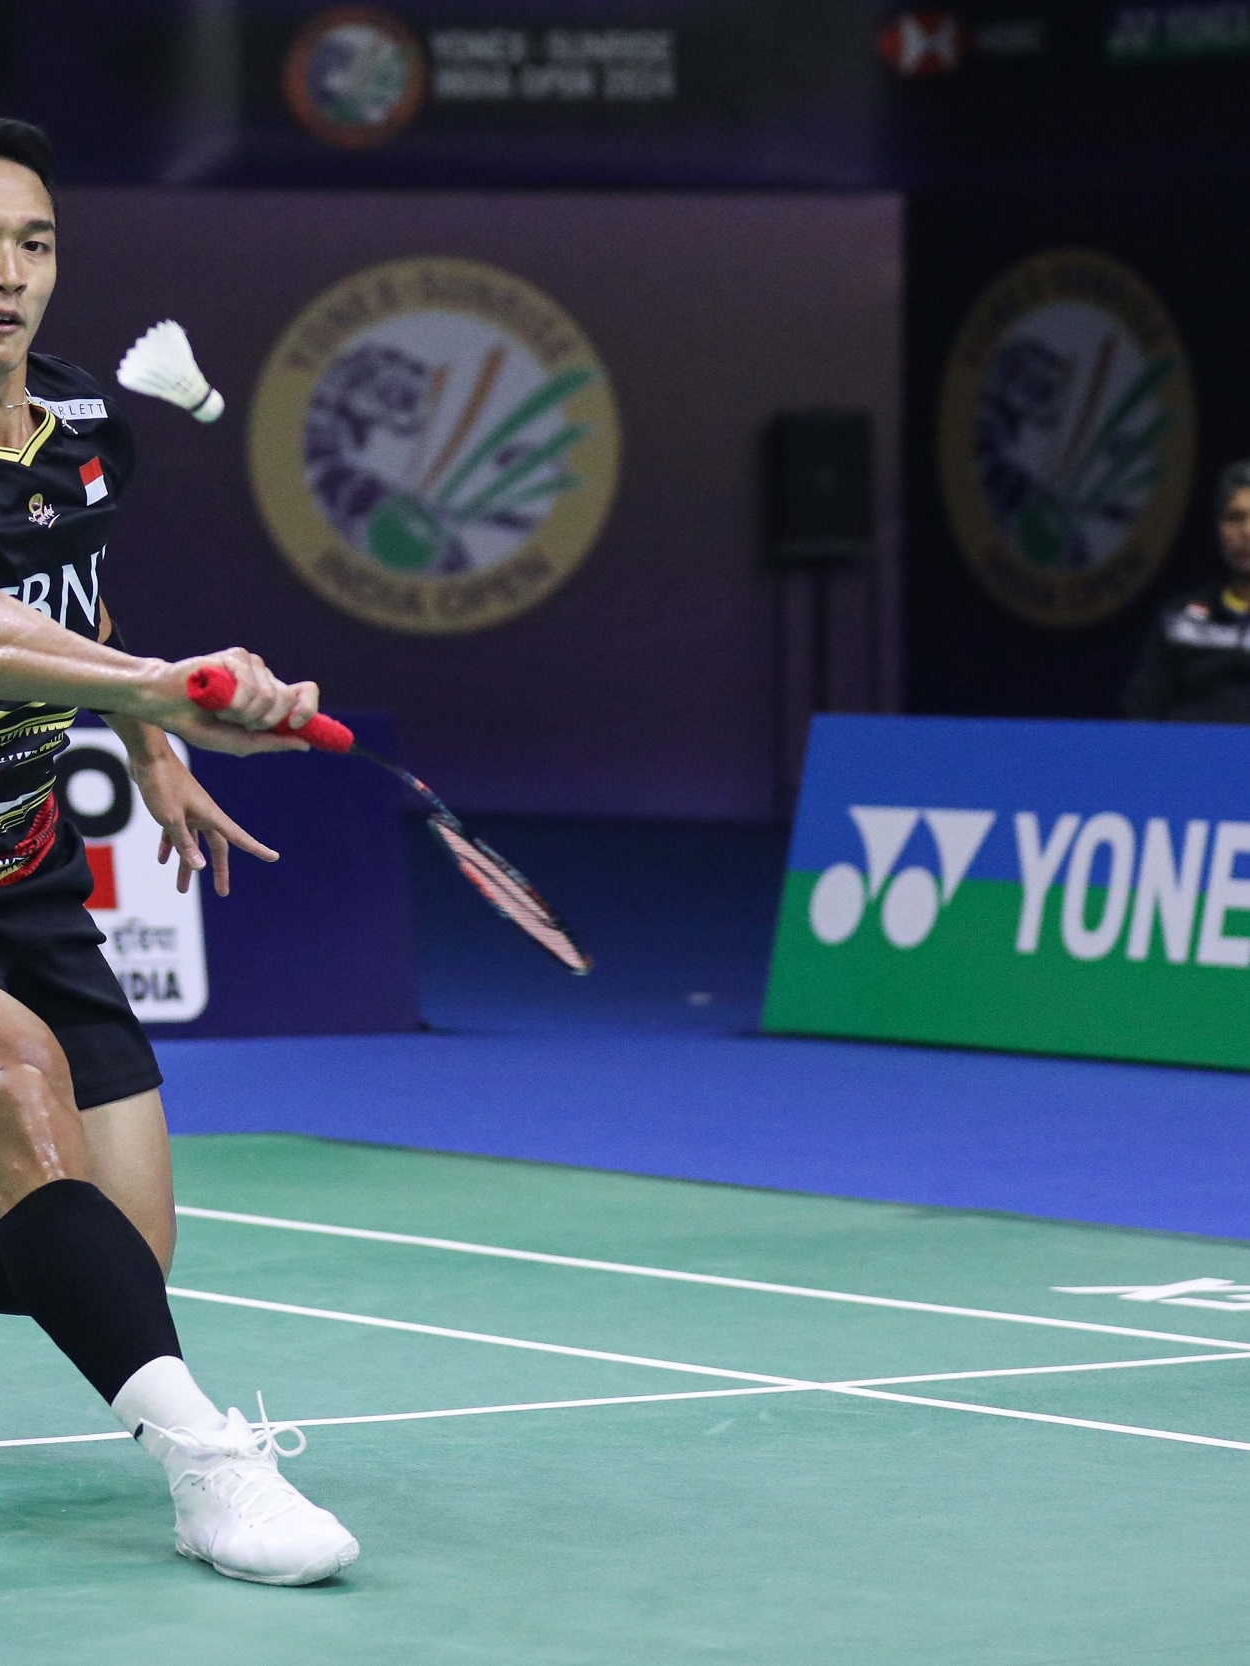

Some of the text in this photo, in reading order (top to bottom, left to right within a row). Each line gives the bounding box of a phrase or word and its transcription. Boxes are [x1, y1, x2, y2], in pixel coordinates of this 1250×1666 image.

[39, 401, 103, 416] ARLETT
[23, 543, 107, 629] BN
[120, 969, 182, 1003] DIA
